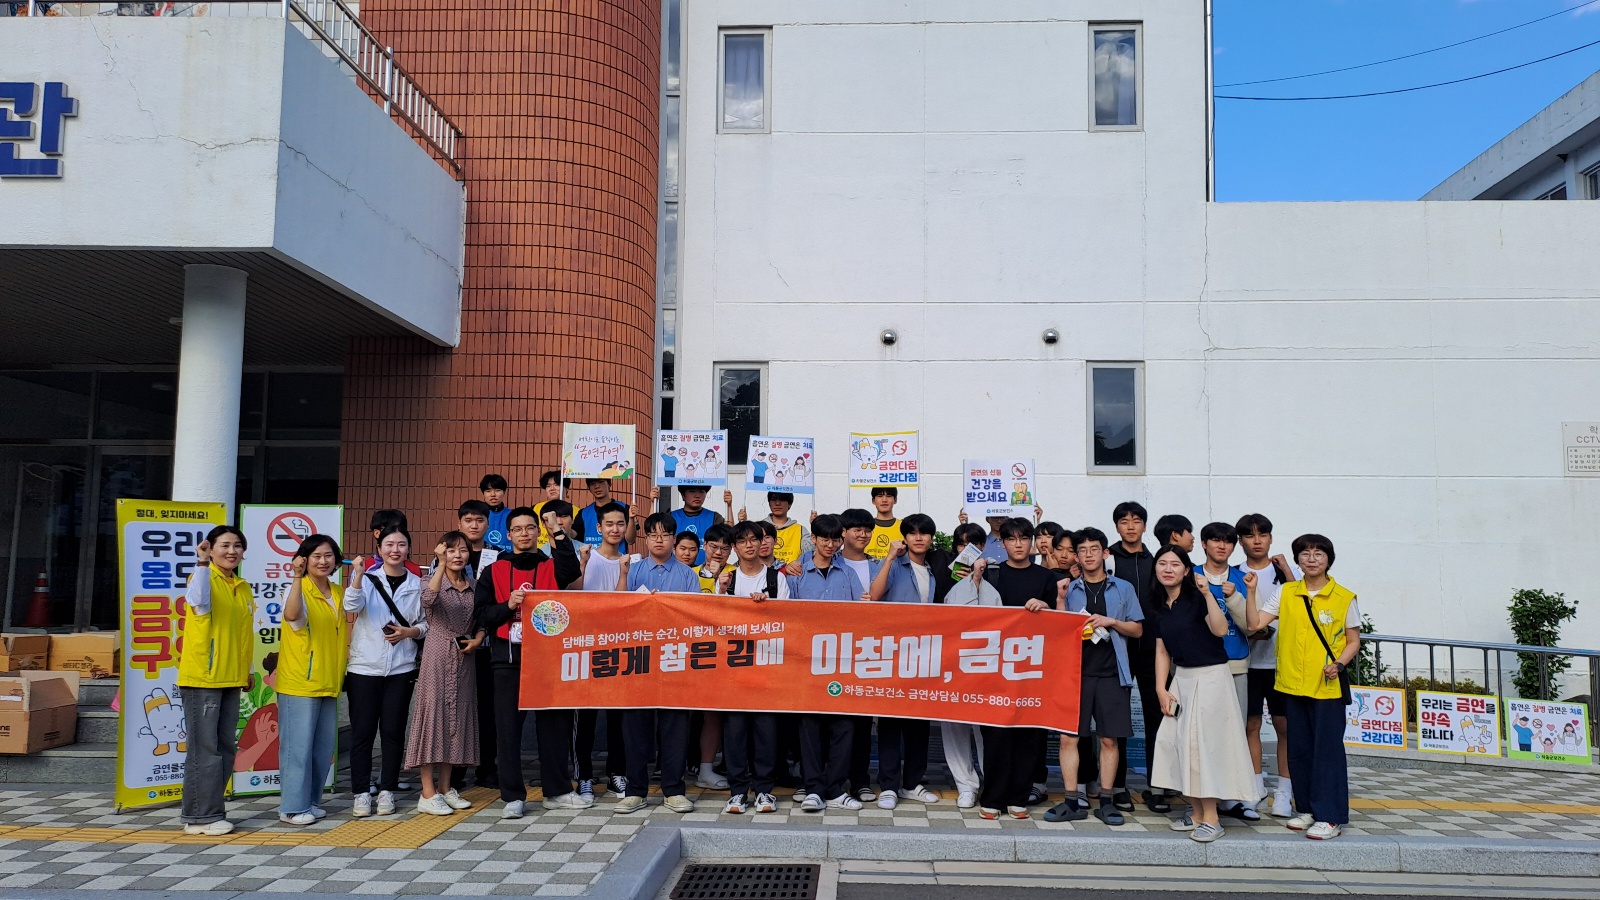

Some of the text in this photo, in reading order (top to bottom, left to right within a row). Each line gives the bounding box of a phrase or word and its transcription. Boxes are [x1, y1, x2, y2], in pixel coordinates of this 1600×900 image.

[661, 434, 678, 442] 흡연은
[693, 434, 710, 442] 금연은
[712, 433, 724, 441] 치료
[879, 460, 917, 470] 금연다짐
[879, 472, 917, 482] 건강다짐
[971, 479, 1002, 490] 건강을
[966, 492, 1007, 502] 받으세요
[136, 509, 209, 519] 절대, 잊지마세요!
[141, 530, 204, 557] 우리
[563, 622, 785, 648] 담배를 참아야 하는 순간, 이렇게 생각해 보세요!
[560, 637, 785, 682] 이렇게 참은 김에
[810, 630, 1045, 684] 이참에, 금연
[844, 684, 1042, 707] 하동군보건소 금연상담실 055-880-6665
[1421, 697, 1496, 714] 우리는 금연을
[1510, 703, 1583, 715] 흡연은 질병 금연은 치료
[1361, 719, 1402, 732] 금연다짐
[1421, 711, 1450, 727] 약속
[1361, 732, 1403, 745] 건강다짐
[1421, 728, 1454, 741] 합니다
[159, 787, 183, 796] 하동군
